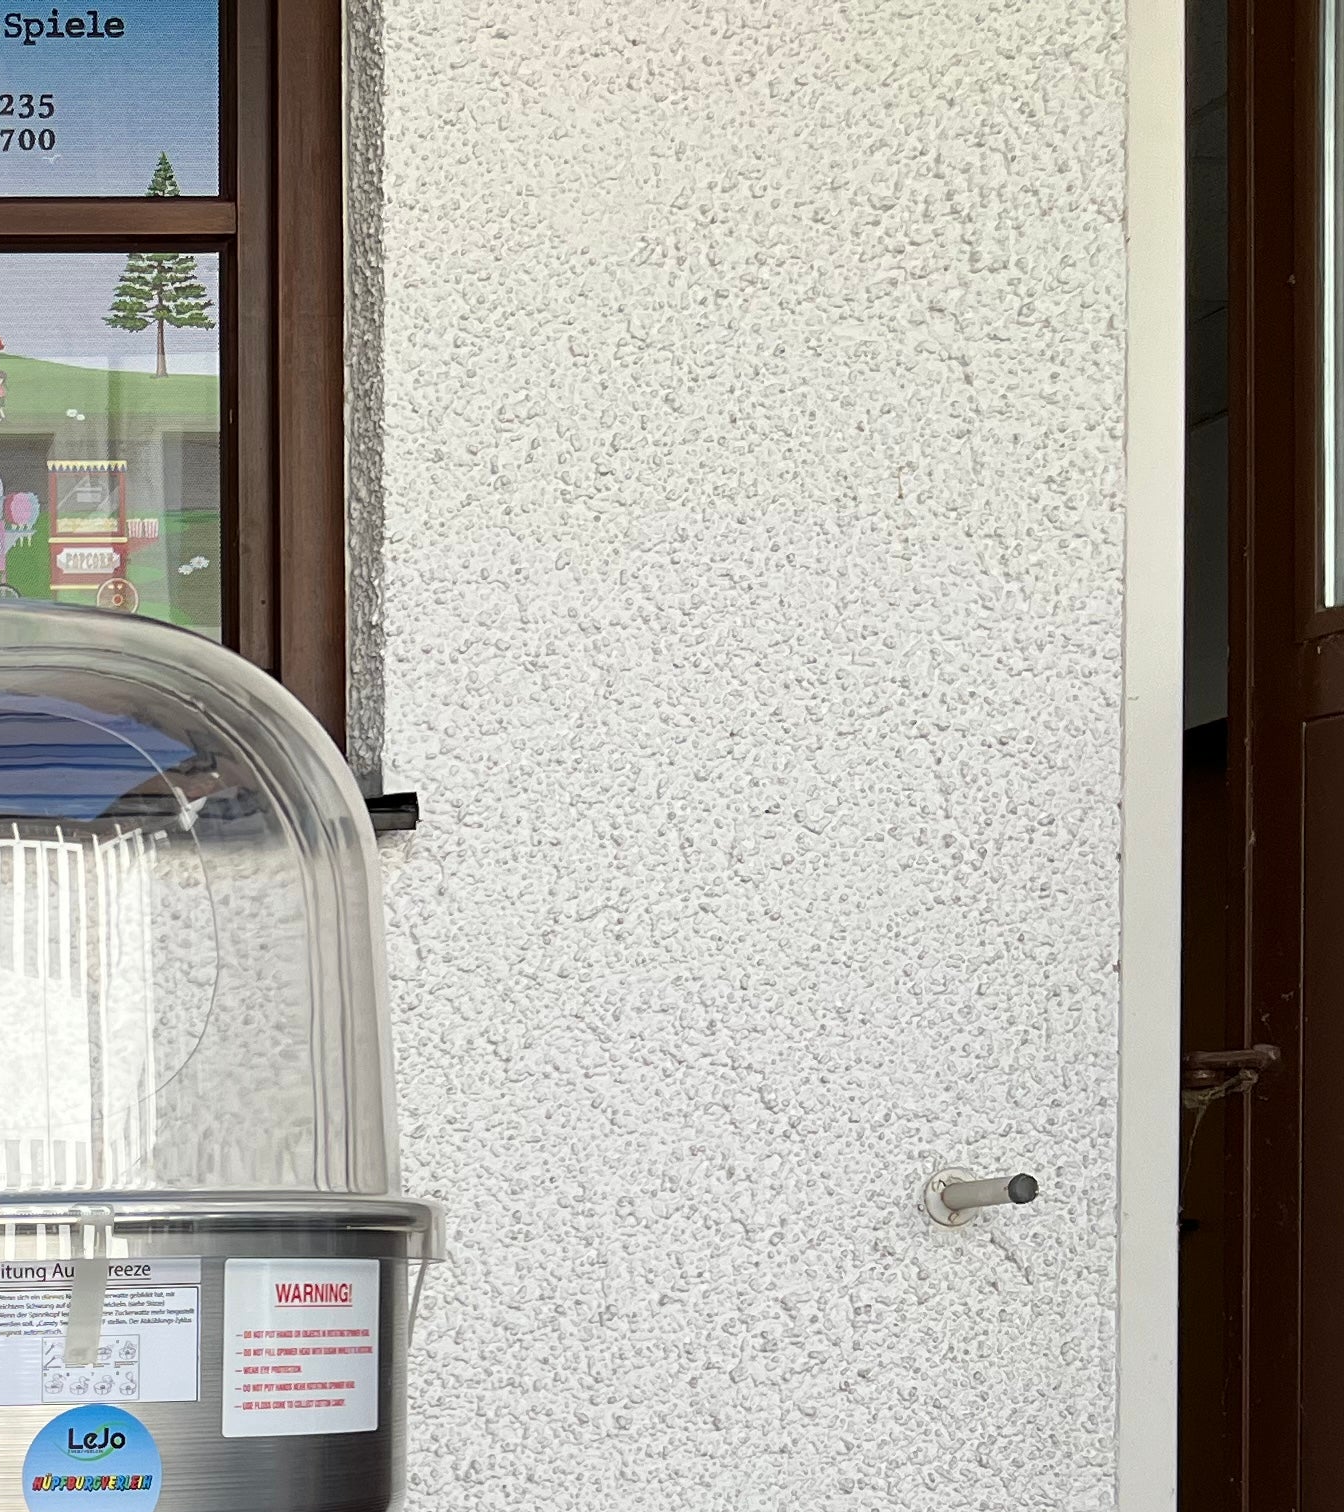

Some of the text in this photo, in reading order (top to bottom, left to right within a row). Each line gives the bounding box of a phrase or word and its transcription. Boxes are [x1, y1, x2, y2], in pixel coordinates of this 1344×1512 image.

[275, 1284, 352, 1303] WARNING!
[68, 1427, 126, 1449] LeJo
[32, 1472, 153, 1492] HÜPFBURGVERLEIH
